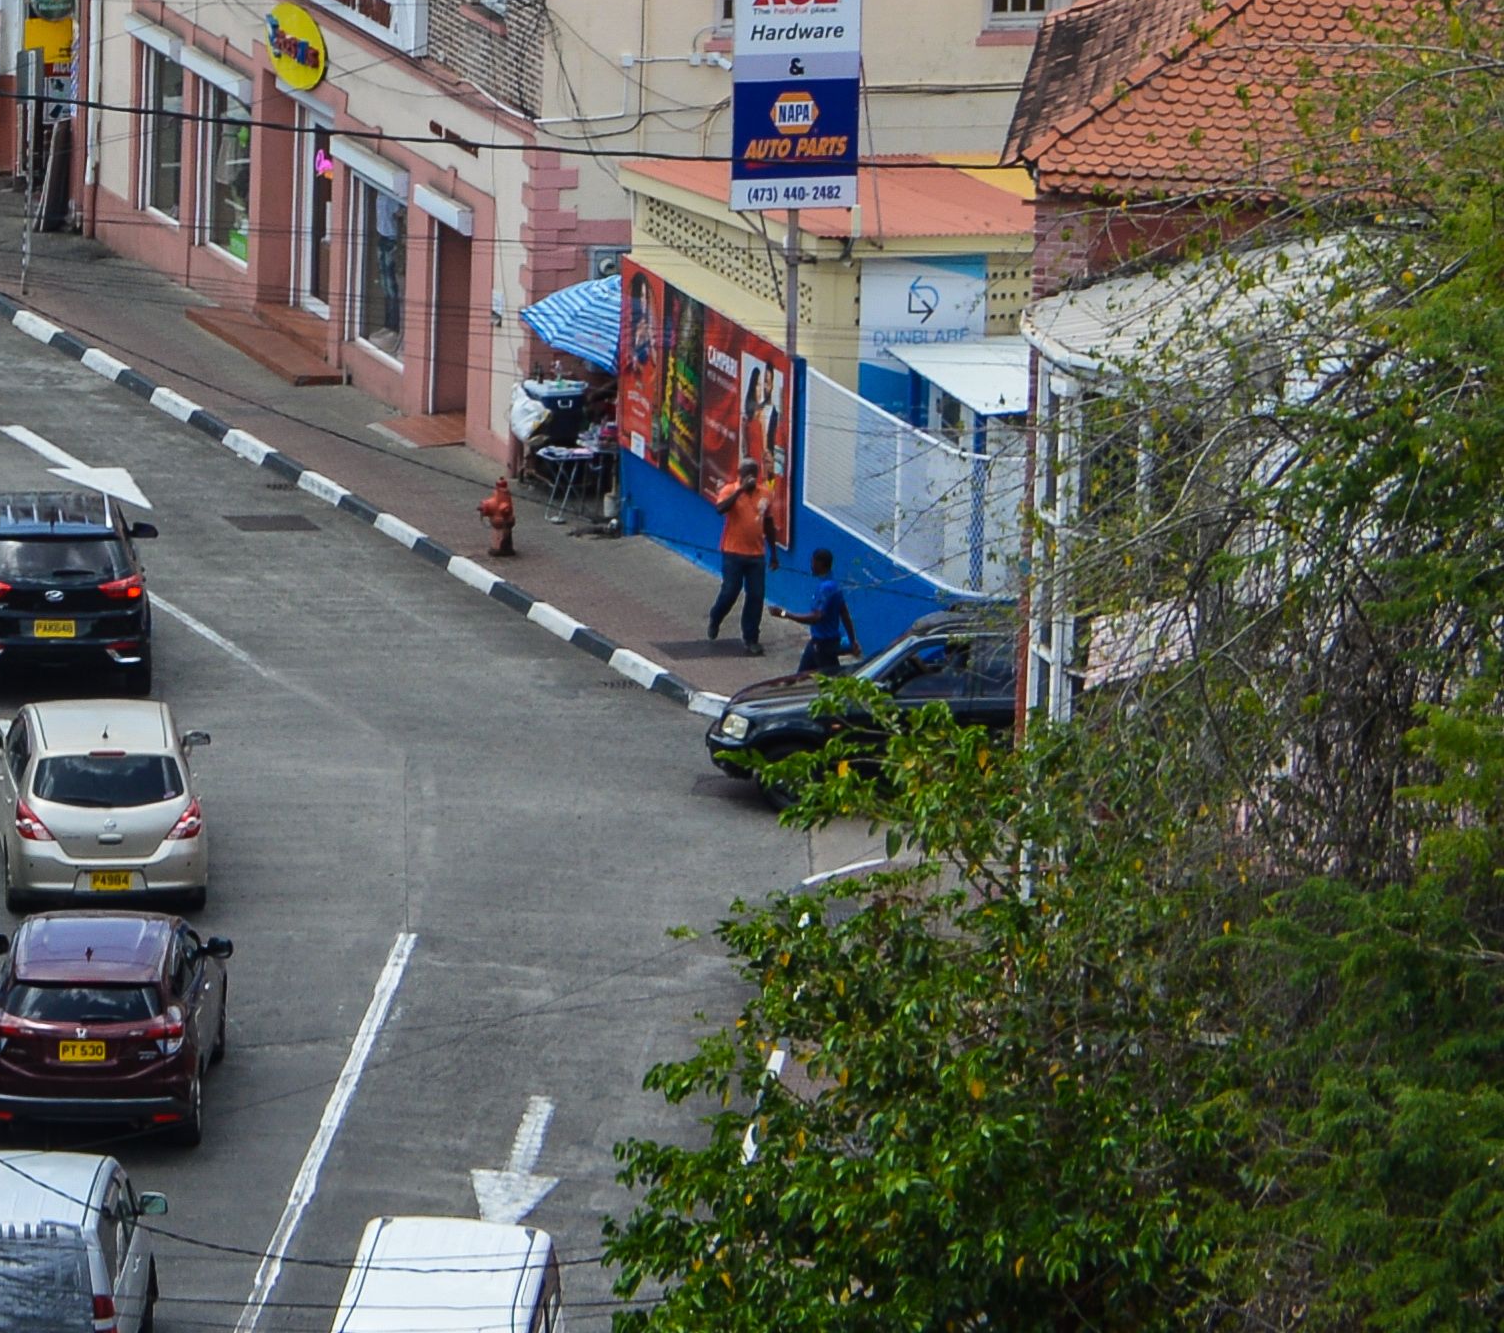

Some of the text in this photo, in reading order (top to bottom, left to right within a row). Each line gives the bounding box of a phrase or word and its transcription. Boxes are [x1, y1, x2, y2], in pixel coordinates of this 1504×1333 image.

[774, 7, 808, 16] helpful
[750, 23, 845, 41] Hardware
[789, 57, 805, 76] &
[778, 104, 810, 123] NAPA
[744, 136, 848, 159] AUTO PARTS
[747, 186, 841, 204] (473) 440-2482
[61, 1044, 76, 1056] PT
